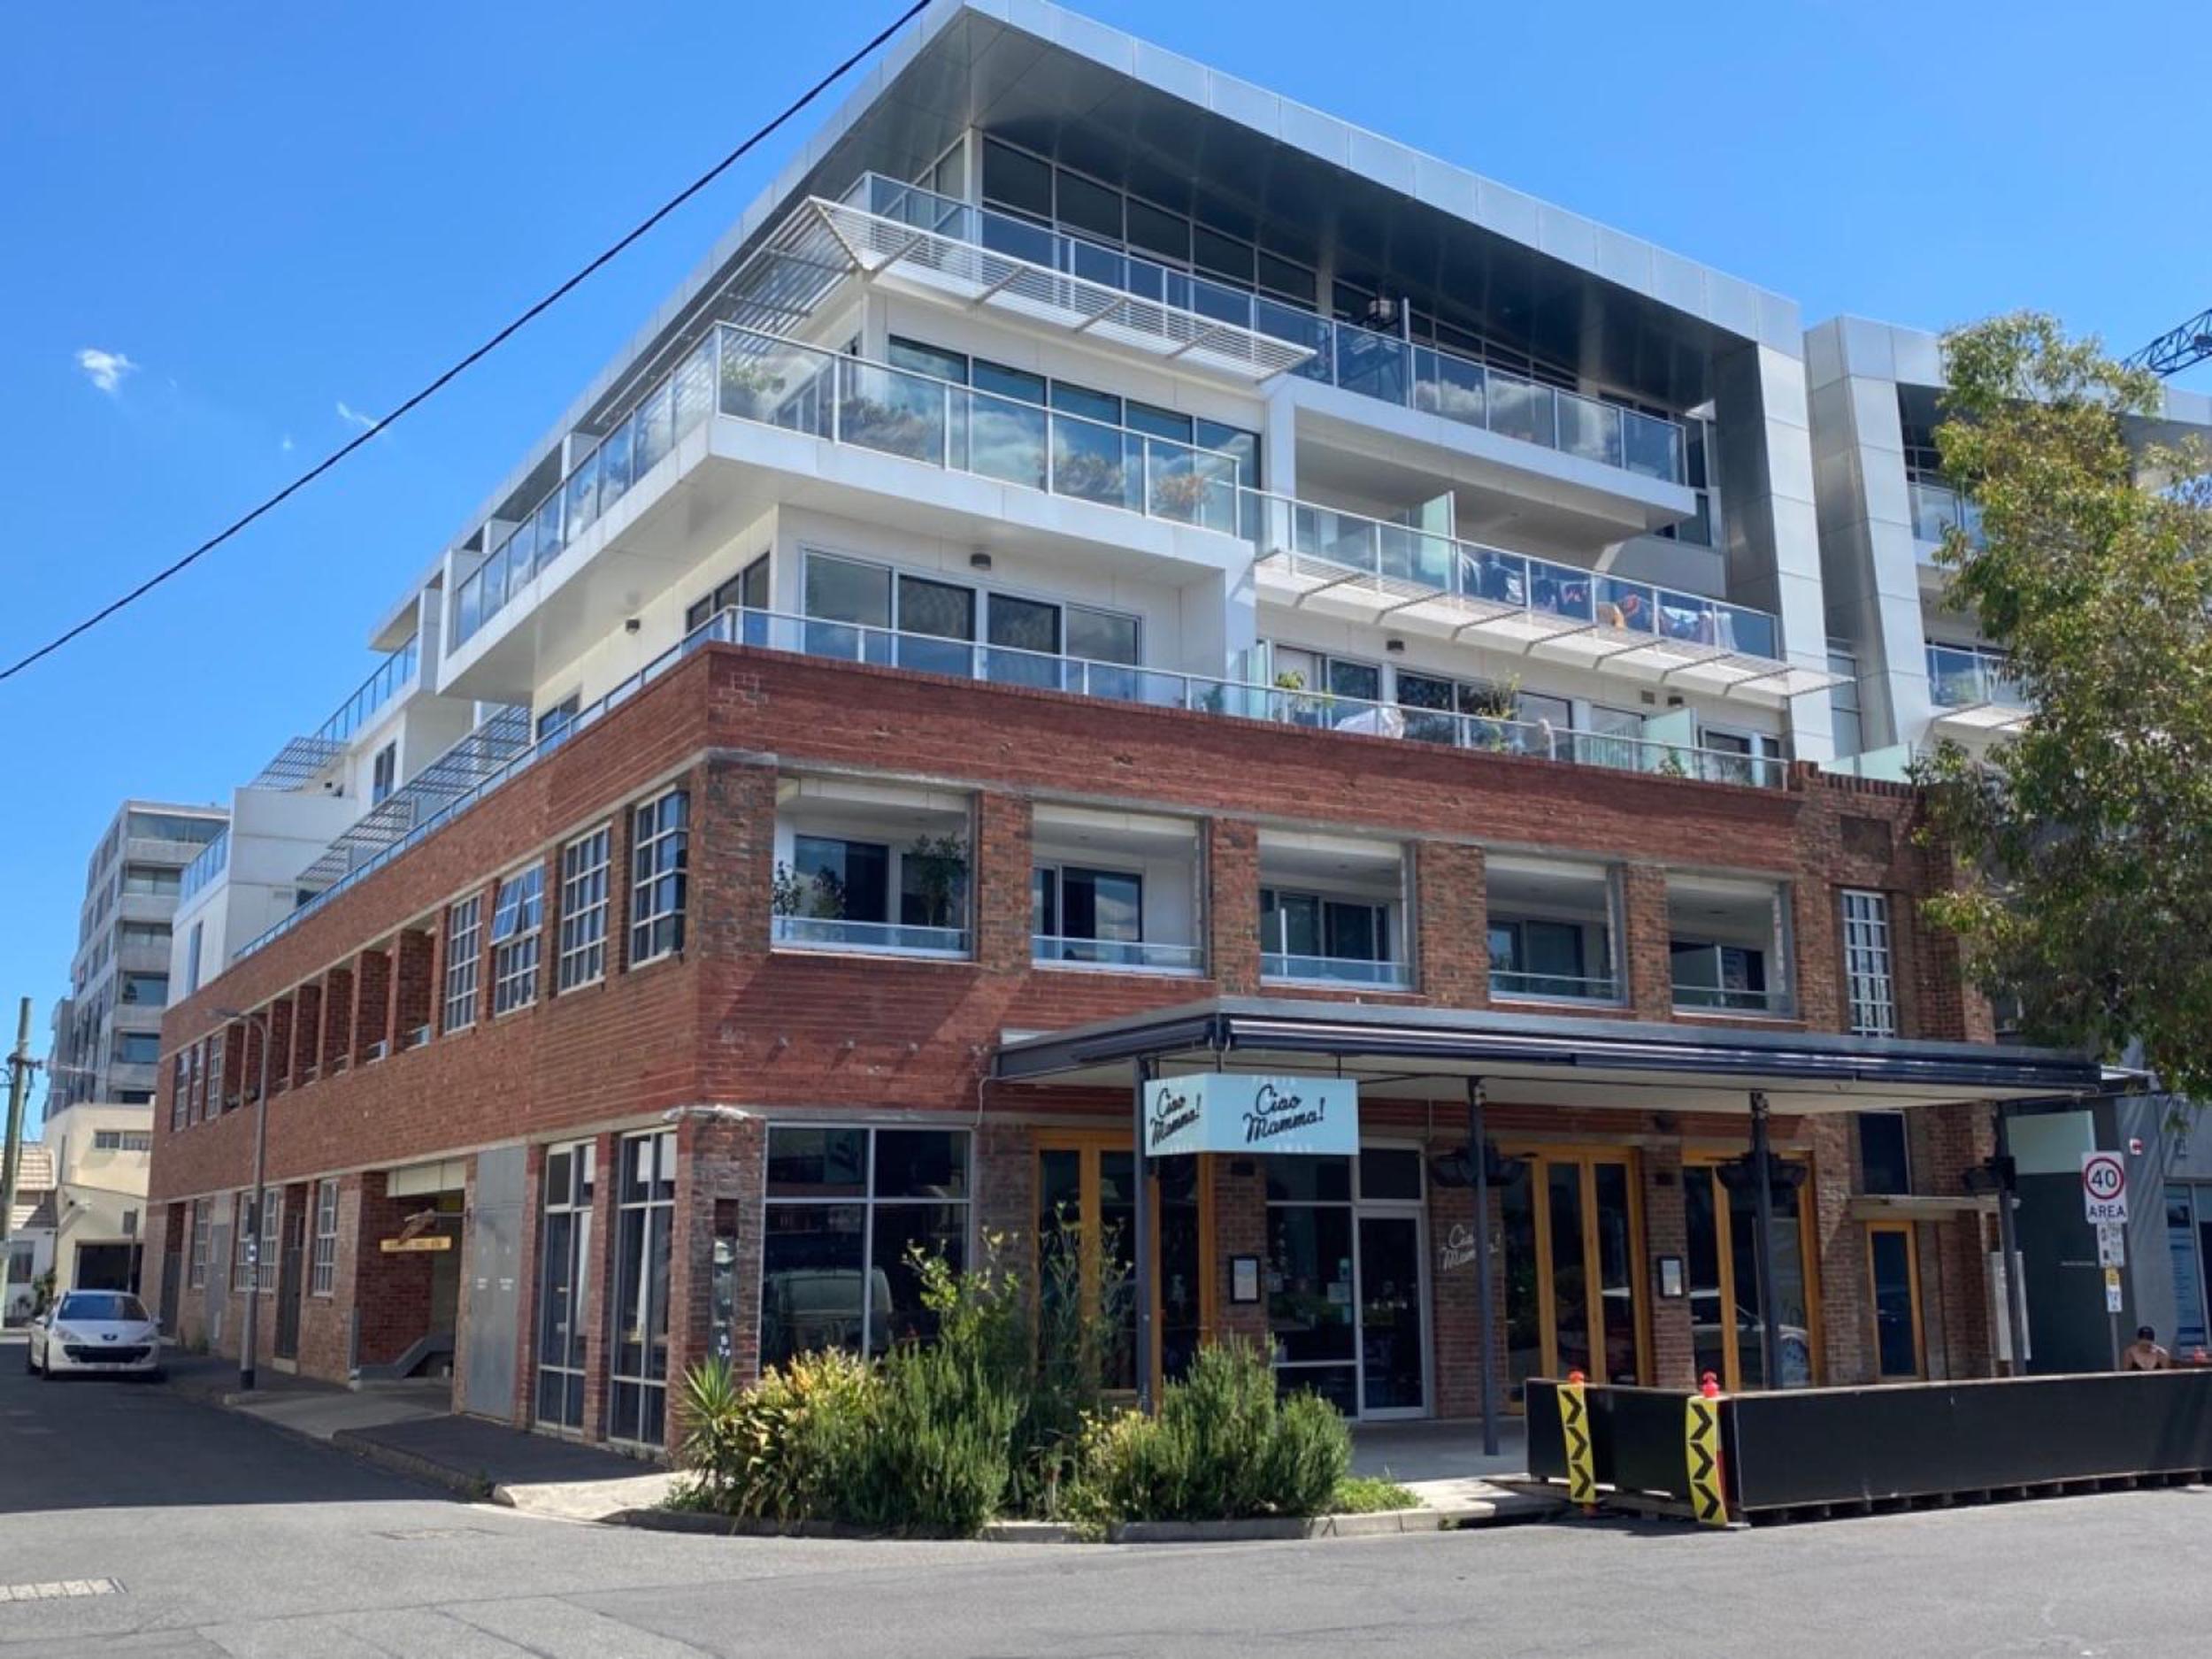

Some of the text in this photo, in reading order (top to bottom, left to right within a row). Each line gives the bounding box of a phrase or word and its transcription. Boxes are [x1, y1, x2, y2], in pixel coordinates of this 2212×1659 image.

[1156, 1087, 1187, 1118] Ciao
[1256, 1083, 1302, 1116] Ciao
[1149, 1093, 1202, 1148] Mamma!
[1242, 1096, 1325, 1144] Mamma!
[2091, 1169, 2117, 1188] 40
[2088, 1205, 2125, 1217] AREA
